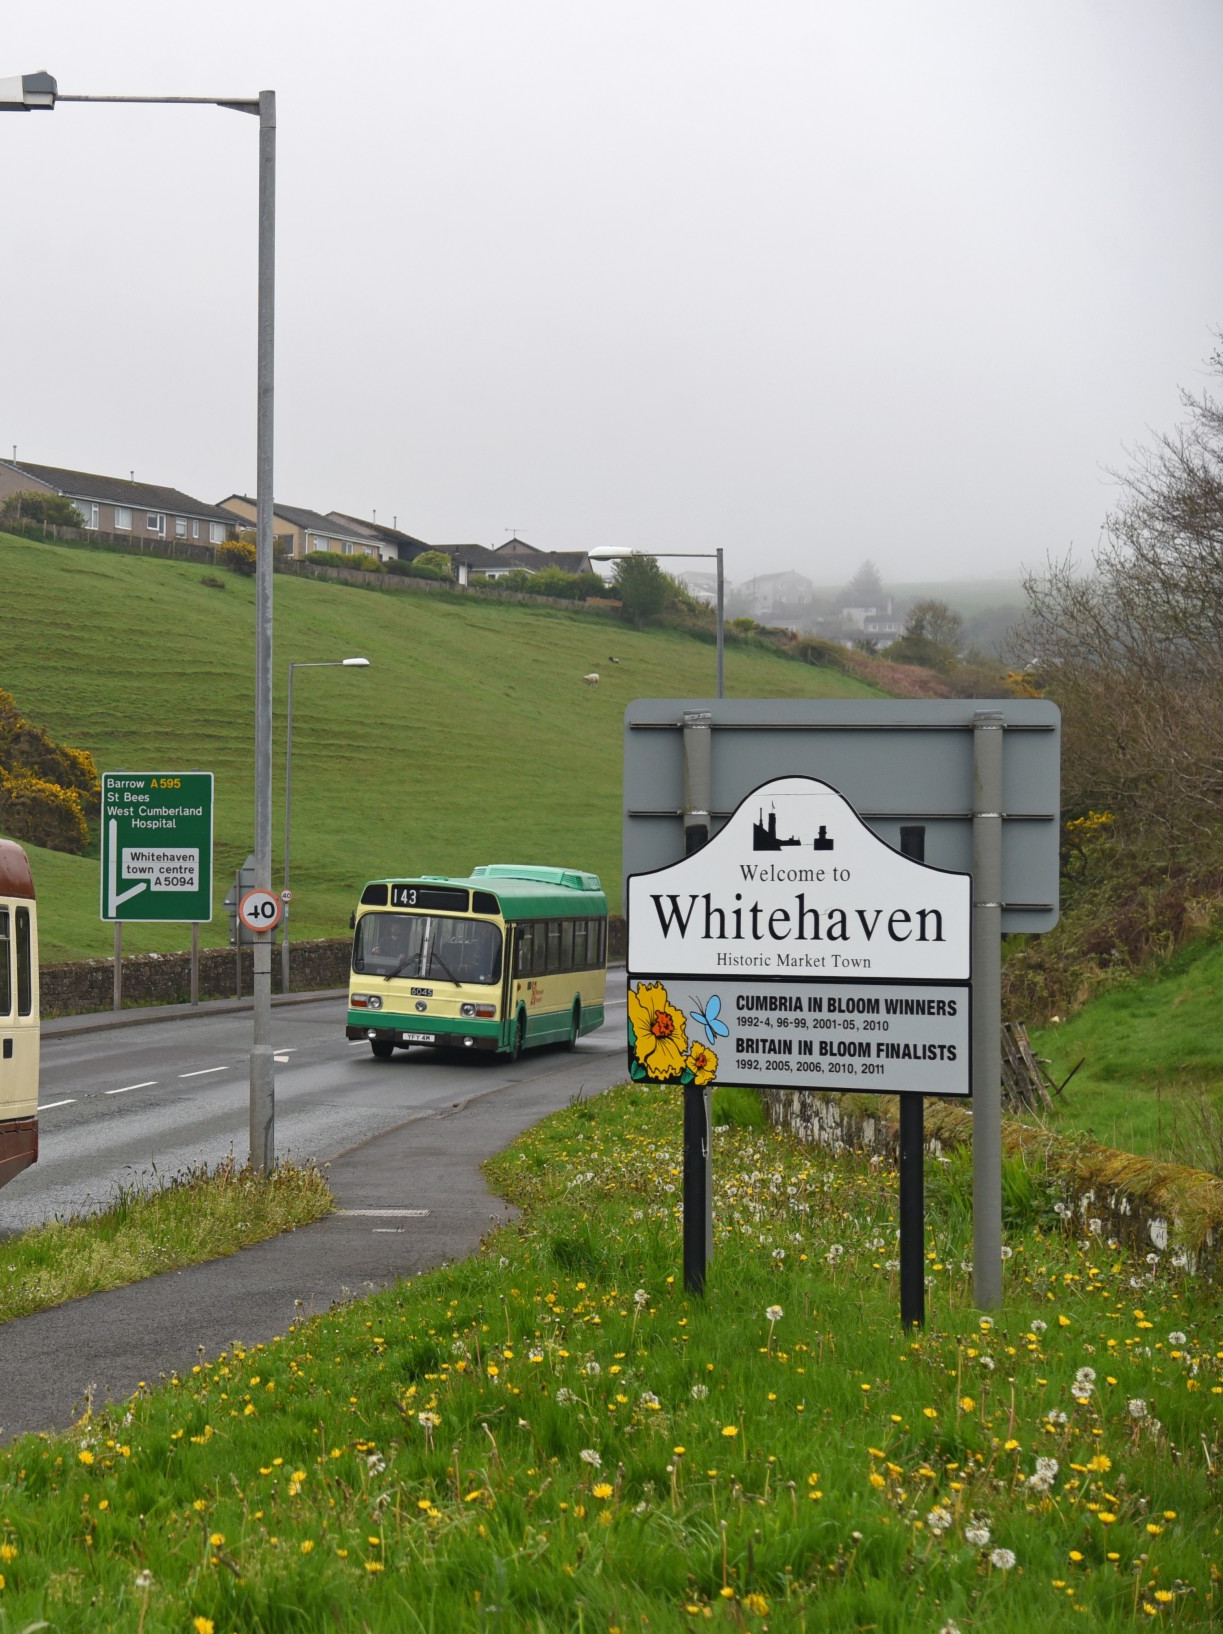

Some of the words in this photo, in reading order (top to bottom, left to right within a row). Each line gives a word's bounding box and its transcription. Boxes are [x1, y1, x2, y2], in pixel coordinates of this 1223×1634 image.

[107, 778, 145, 789] Barrow
[107, 792, 120, 802] St
[124, 792, 150, 802] Bees
[107, 806, 134, 816] West
[138, 805, 203, 816] Cumberland
[131, 818, 177, 830] Hospital
[130, 851, 195, 862] Whitehaven
[126, 864, 154, 874] town
[159, 864, 195, 874] centre
[739, 864, 826, 882] Welcome
[833, 866, 851, 882] to
[393, 888, 417, 905] 143
[649, 892, 947, 942] Whitehaven
[716, 952, 771, 967] Historic
[777, 953, 826, 968] Market
[831, 954, 872, 968] Town
[411, 988, 434, 997] 6045
[736, 994, 804, 1013] CUMBRIA
[808, 996, 823, 1013] IN
[827, 996, 880, 1015] BLOOM
[884, 998, 958, 1017] WINNERS
[736, 1016, 774, 1029] 1992-4,
[776, 1017, 809, 1030] 96-99,
[812, 1018, 860, 1032] 2001-05,
[862, 1020, 889, 1031] 2010
[736, 1037, 793, 1056] BRITAIN
[798, 1039, 814, 1056] IN
[819, 1040, 872, 1058] BLOOM
[876, 1042, 958, 1062] FINALISTS
[735, 1059, 763, 1072] 1992,
[765, 1060, 793, 1073] 2005,
[796, 1061, 825, 1074] 2006,
[828, 1062, 858, 1076] 2010,
[861, 1063, 885, 1075] 2011
